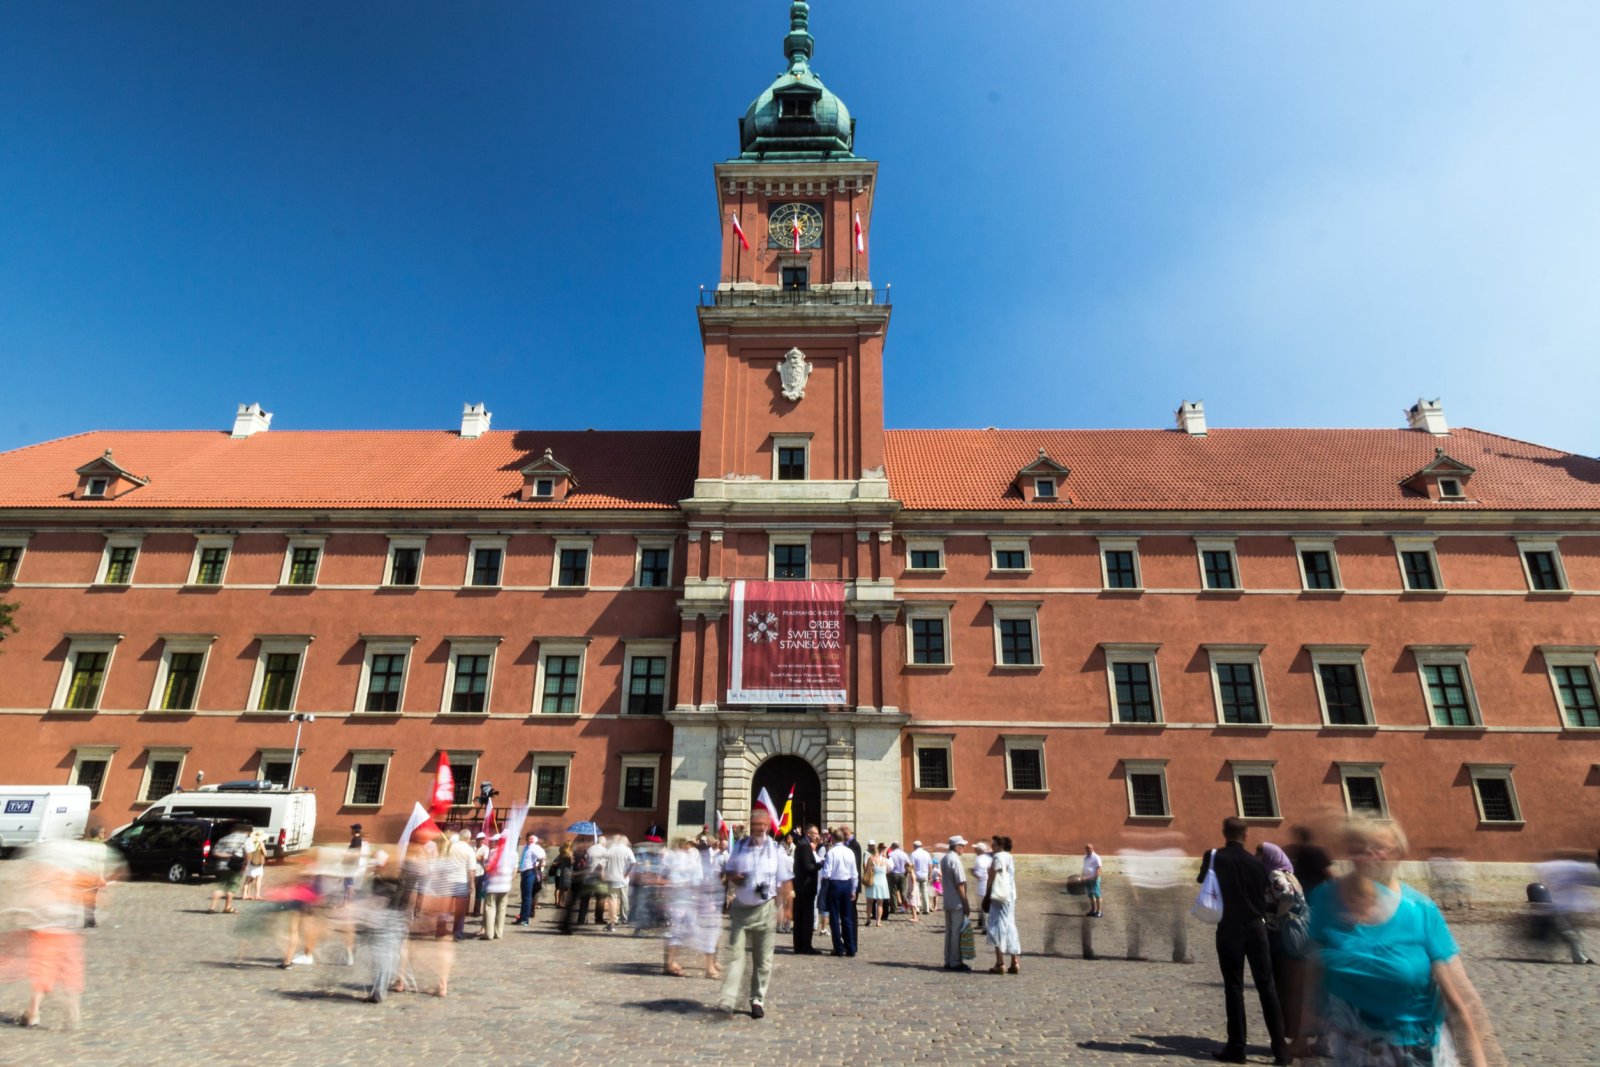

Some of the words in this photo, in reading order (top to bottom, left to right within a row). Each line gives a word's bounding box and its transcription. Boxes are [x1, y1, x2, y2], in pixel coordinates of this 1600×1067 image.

[809, 620, 840, 629] ORDER
[788, 628, 840, 640] ŚWIĘTEGO
[780, 640, 840, 649] STANISŁAWA
[9, 802, 29, 811] TVP
